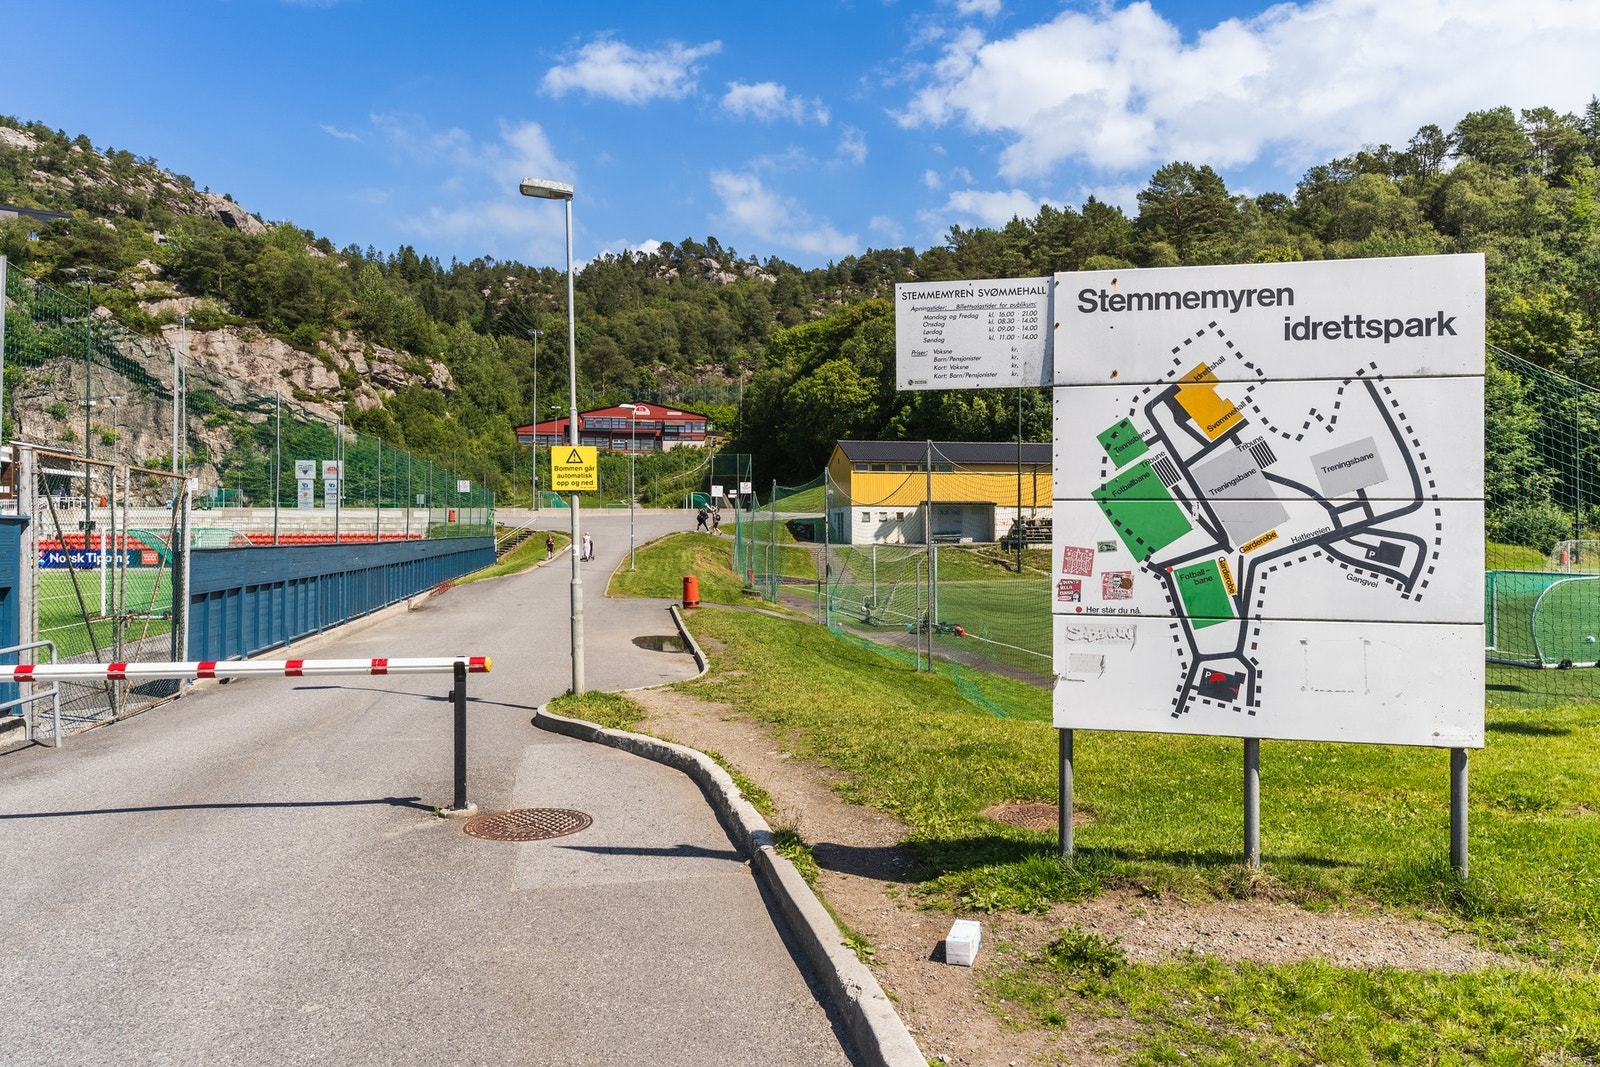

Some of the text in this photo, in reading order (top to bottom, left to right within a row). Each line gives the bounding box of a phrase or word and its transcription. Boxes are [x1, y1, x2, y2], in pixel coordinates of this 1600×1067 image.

[901, 286, 1047, 300] STEMMEMYREN SVØMMEHALL
[1077, 287, 1295, 313] Stemmemyren
[958, 312, 979, 320] Fredag
[997, 317, 1015, 325] 08.30
[922, 328, 943, 336] Lørdag
[997, 325, 1016, 333] 09.00
[1284, 311, 1458, 344] idrettspark
[999, 333, 1015, 341] 11.00
[1193, 355, 1226, 382] Idrettshall
[1206, 400, 1247, 432] Svømmehall
[1113, 428, 1151, 454] Tennisbane
[1236, 434, 1264, 453] Tribune
[1139, 450, 1166, 468] Tribune
[1321, 451, 1375, 475] Treningsbane
[1111, 471, 1151, 498] Fotballbane
[1208, 467, 1257, 496] Treningsbane
[1238, 531, 1278, 554] Garderobe
[50, 552, 85, 563] Nosk
[85, 552, 130, 566] Tippng
[1368, 550, 1376, 558] P
[1194, 575, 1213, 585] bane
[1218, 556, 1235, 595] Garderobe
[1346, 573, 1379, 589] Gangvei
[1117, 606, 1128, 614] du
[1130, 606, 1142, 615] nå.
